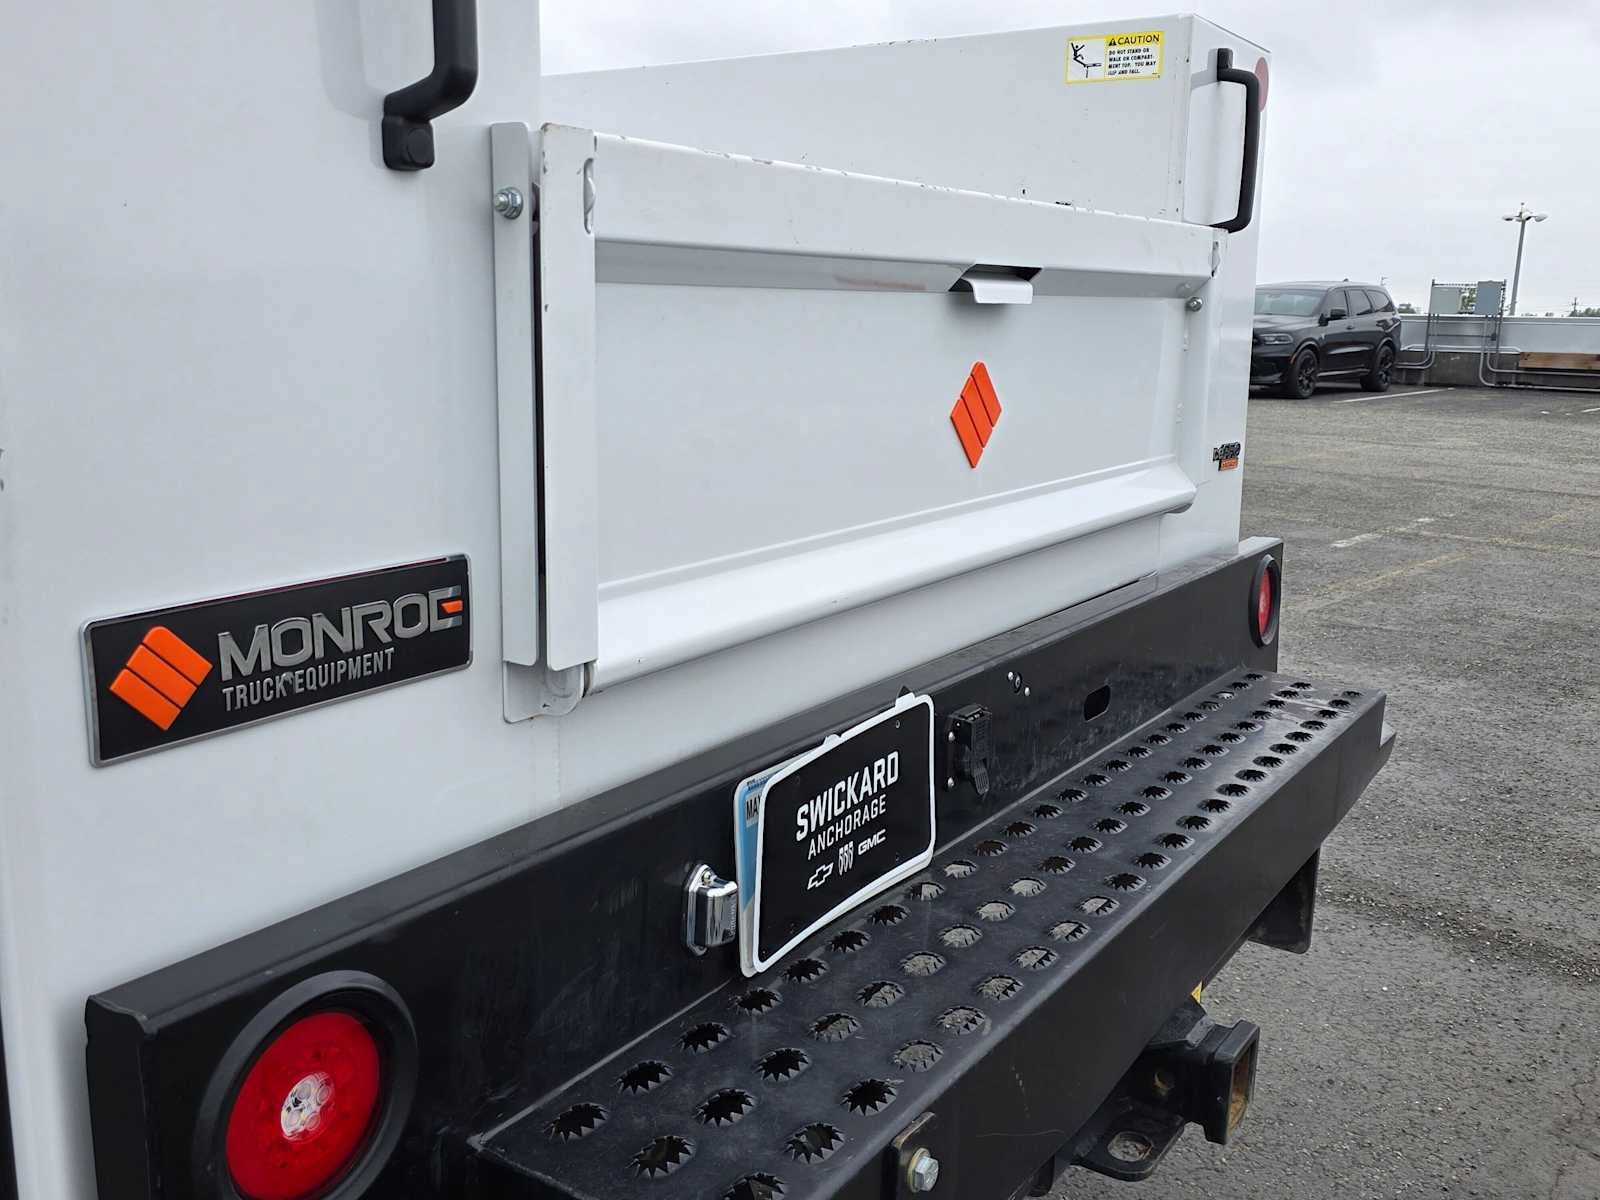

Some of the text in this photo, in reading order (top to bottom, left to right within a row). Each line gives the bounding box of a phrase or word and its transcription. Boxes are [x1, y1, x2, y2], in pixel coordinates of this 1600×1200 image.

[1118, 34, 1160, 45] CAUTION
[217, 585, 464, 681] MONROE
[222, 647, 395, 712] TRUCK EQUIPMENT
[795, 750, 899, 842] SWICKARD
[808, 794, 887, 861] ANCHORAGE
[858, 828, 887, 856] GMC
